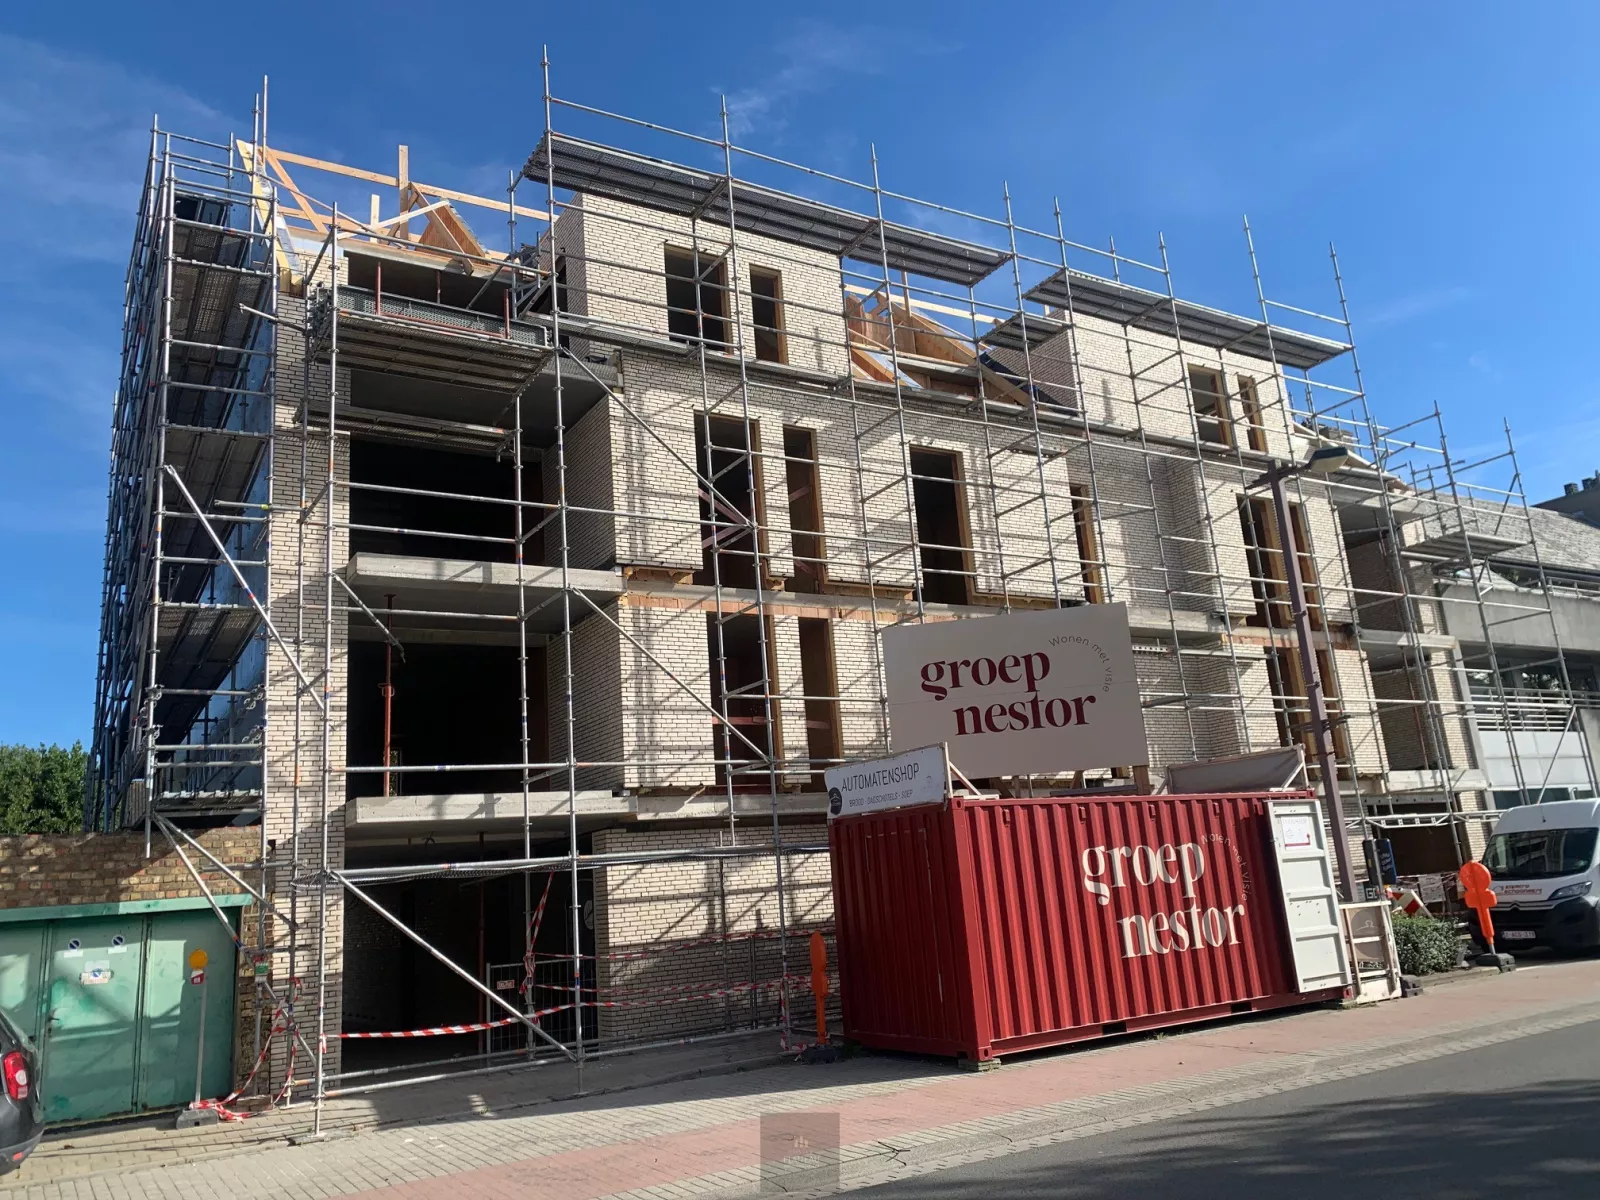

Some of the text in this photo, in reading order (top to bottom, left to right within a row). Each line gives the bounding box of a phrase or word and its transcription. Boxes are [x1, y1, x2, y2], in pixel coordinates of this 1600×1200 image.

[920, 651, 1050, 701] groep
[1048, 635, 1113, 692] Wonen met visie
[952, 691, 1097, 736] nestor
[841, 762, 920, 792] AUTOMATENSHOP
[1082, 842, 1205, 906] groep
[1116, 897, 1245, 959] nestor
